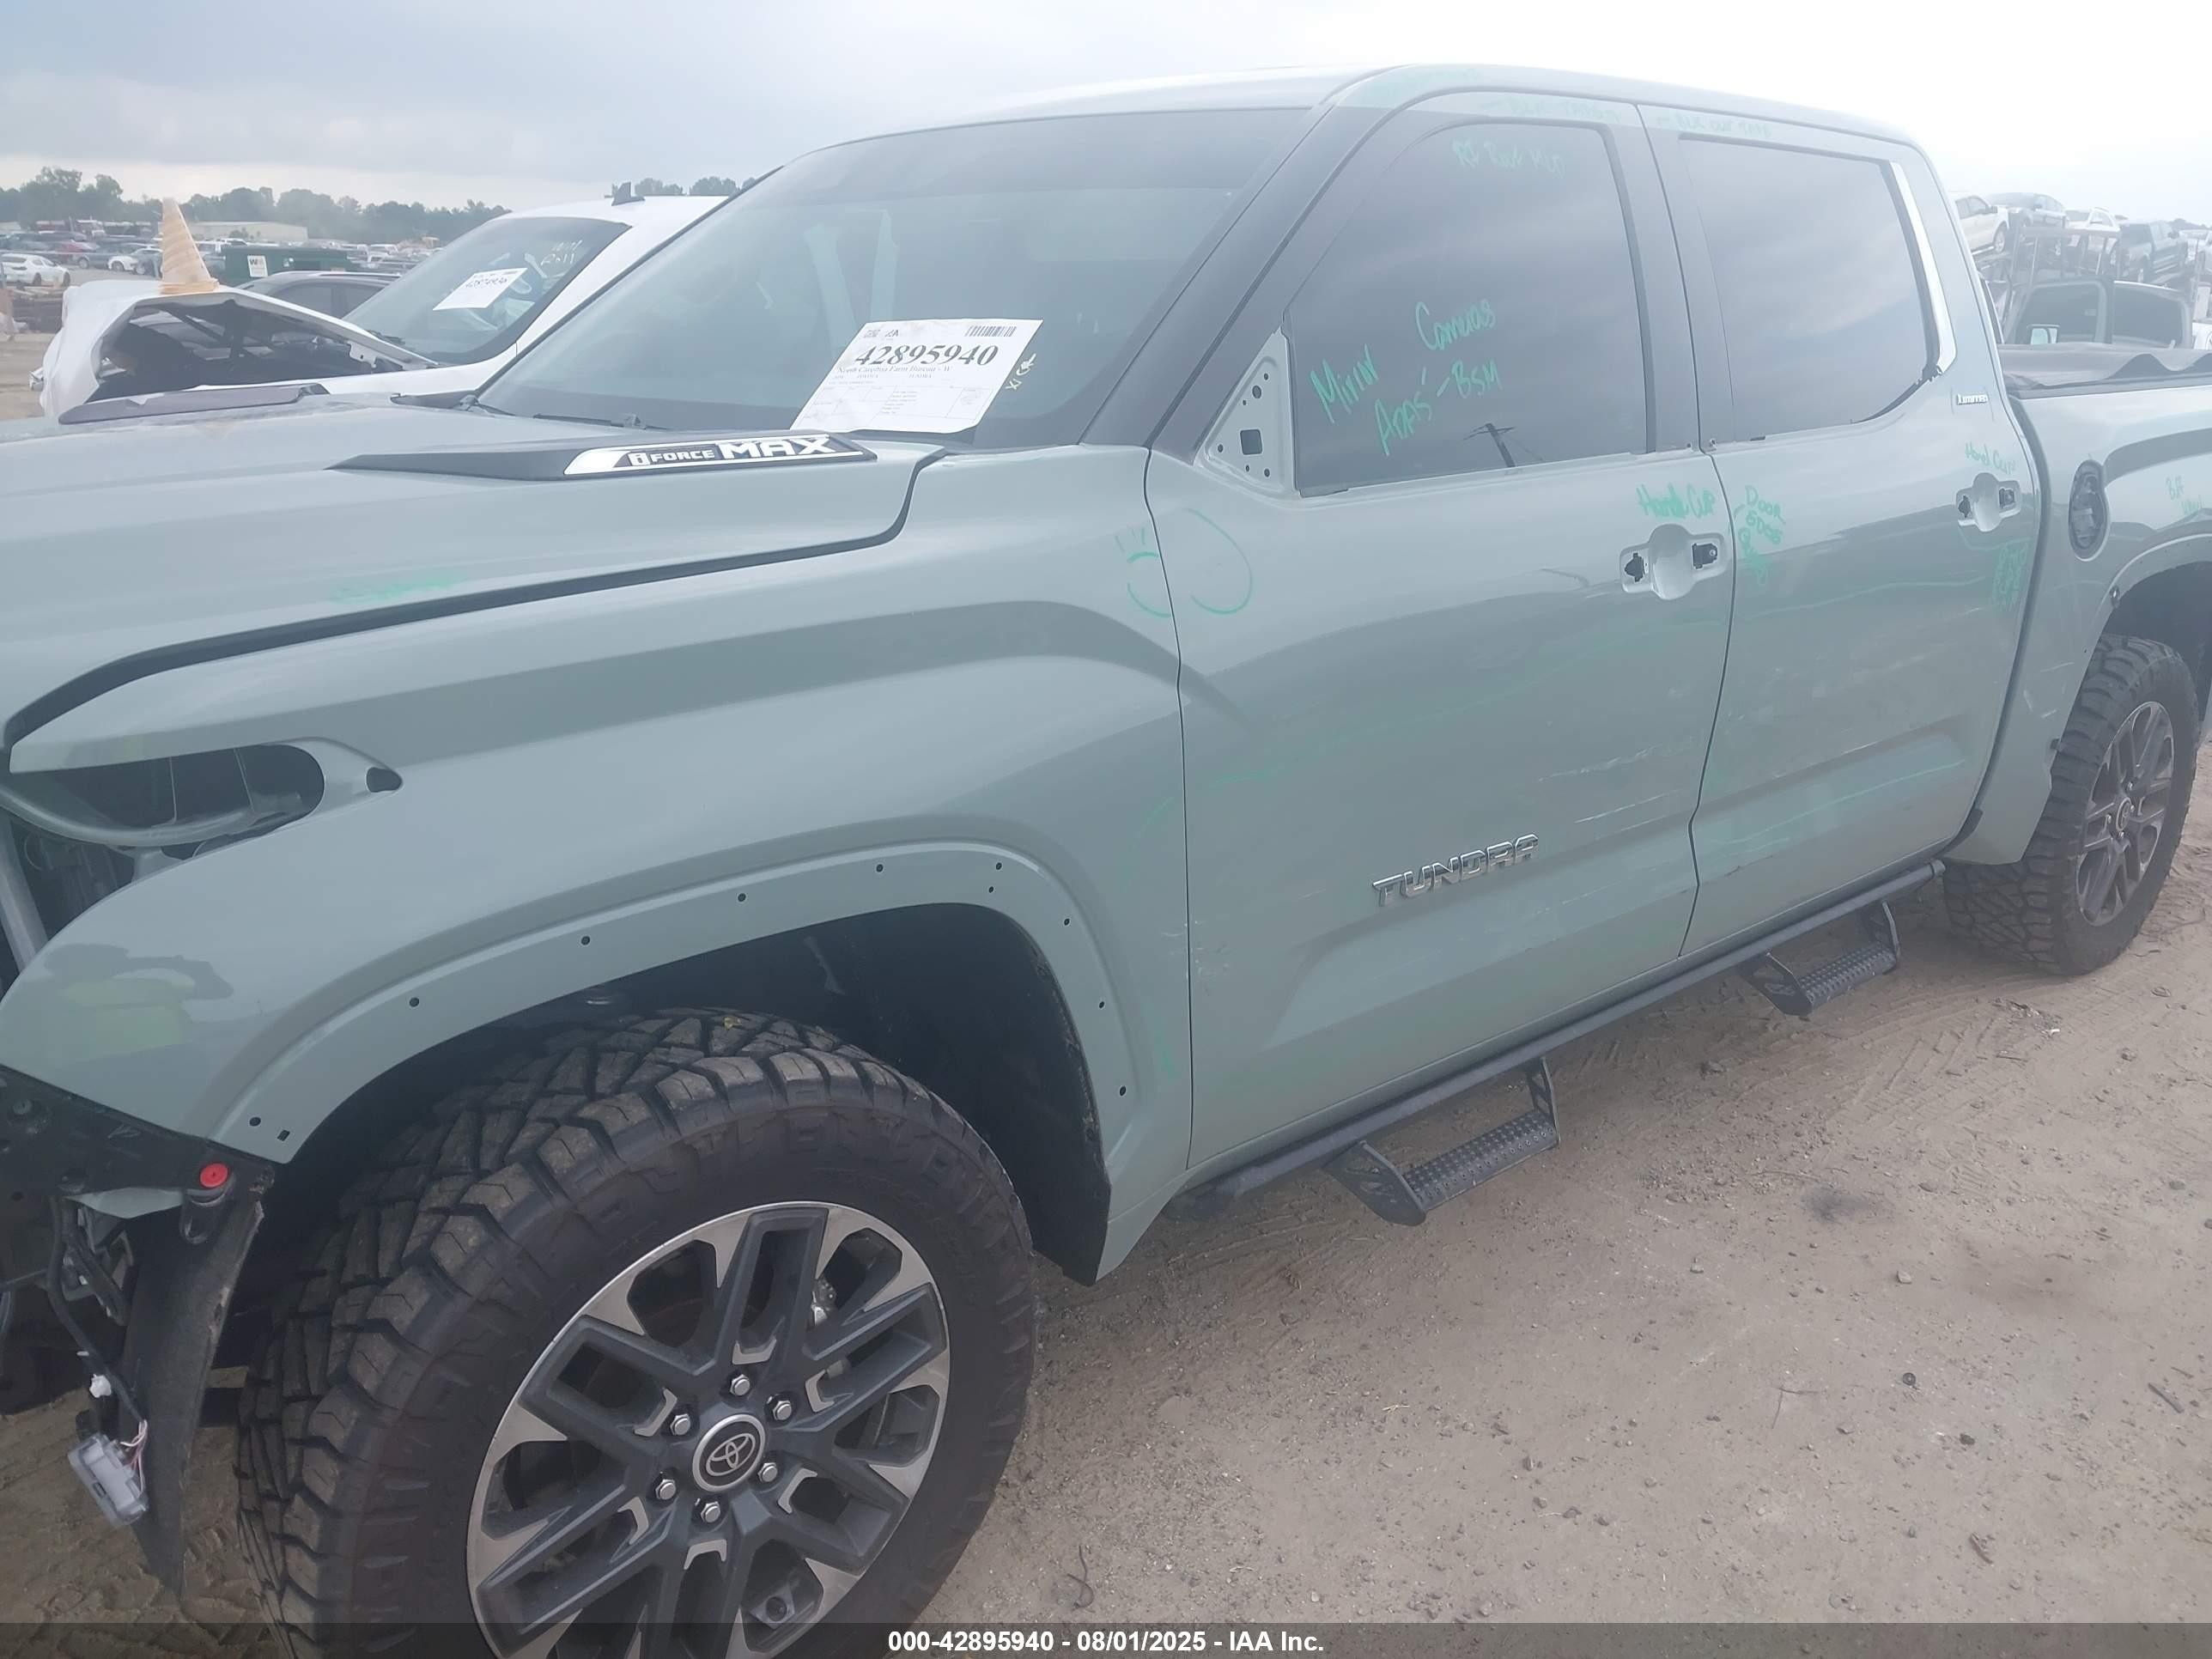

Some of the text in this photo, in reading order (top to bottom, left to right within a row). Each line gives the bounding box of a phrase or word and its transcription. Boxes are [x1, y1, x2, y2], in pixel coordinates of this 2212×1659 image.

[854, 344, 999, 367] 42895940
[718, 436, 836, 459] MAX
[1372, 832, 1539, 908] TUNDRA
